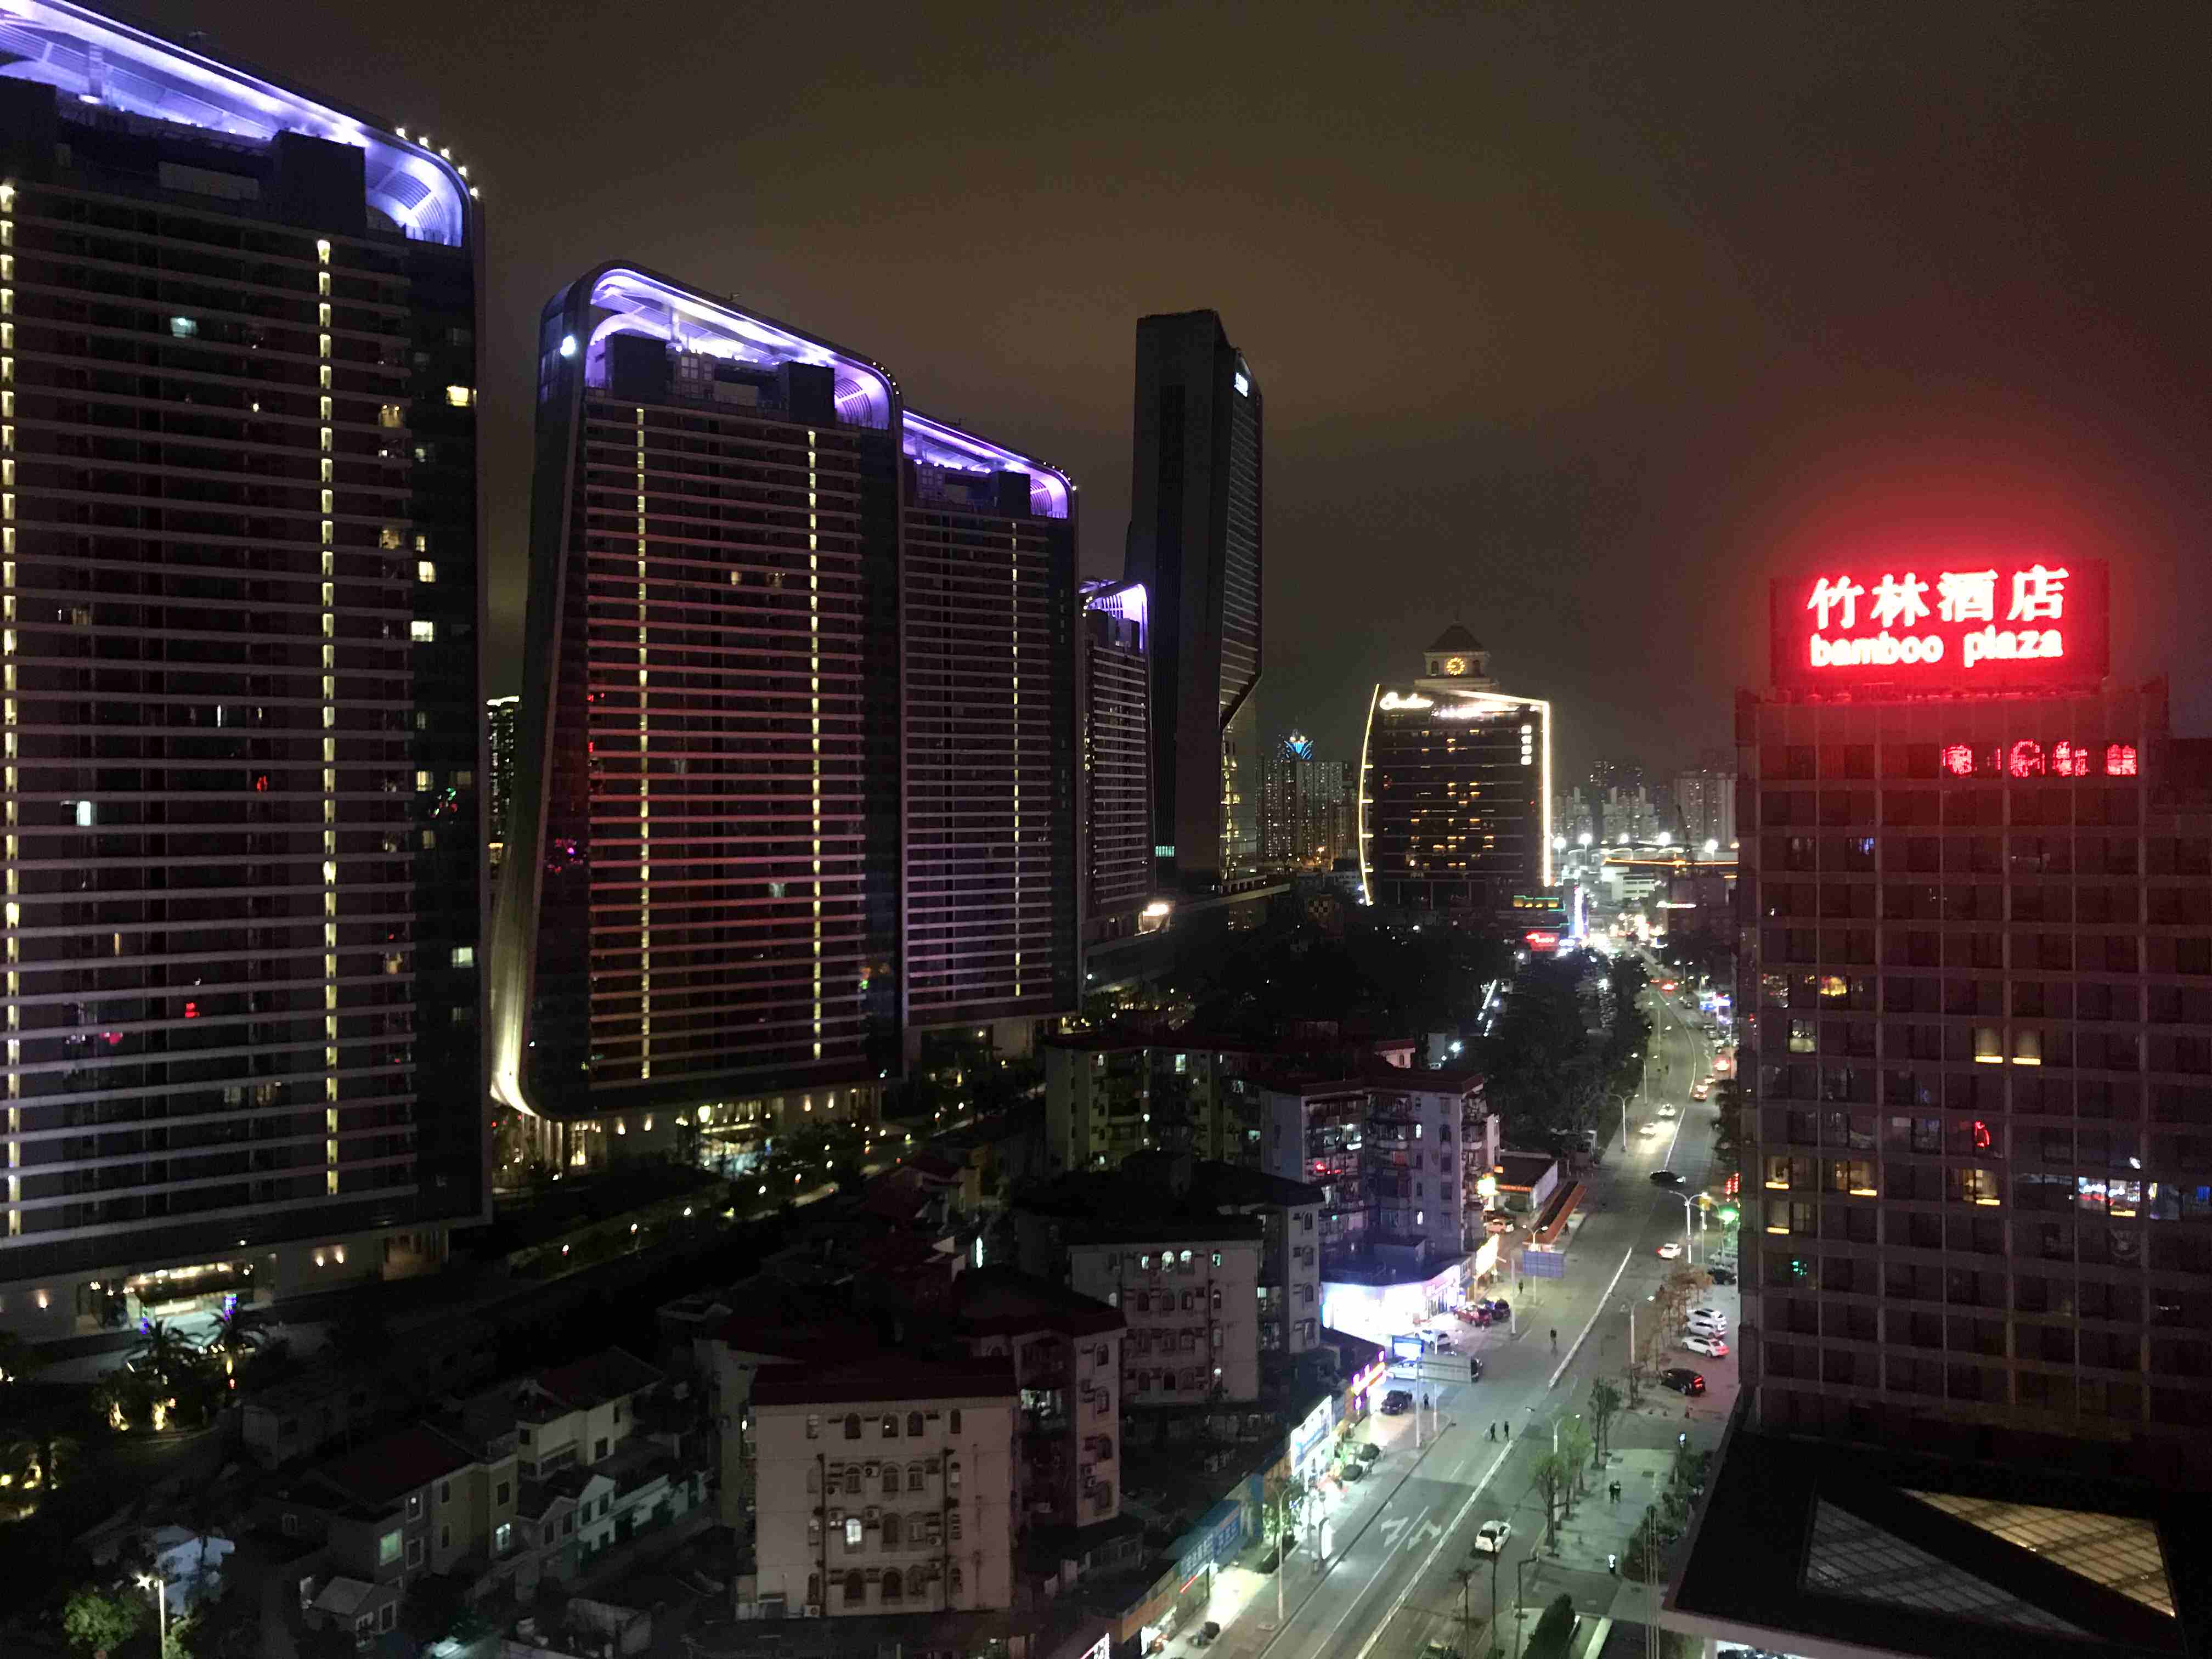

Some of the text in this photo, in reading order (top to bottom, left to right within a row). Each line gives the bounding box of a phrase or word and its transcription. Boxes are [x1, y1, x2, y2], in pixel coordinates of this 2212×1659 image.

[1808, 564, 2069, 630] 竹林酒店
[1810, 624, 2063, 668] bamboo plaza
